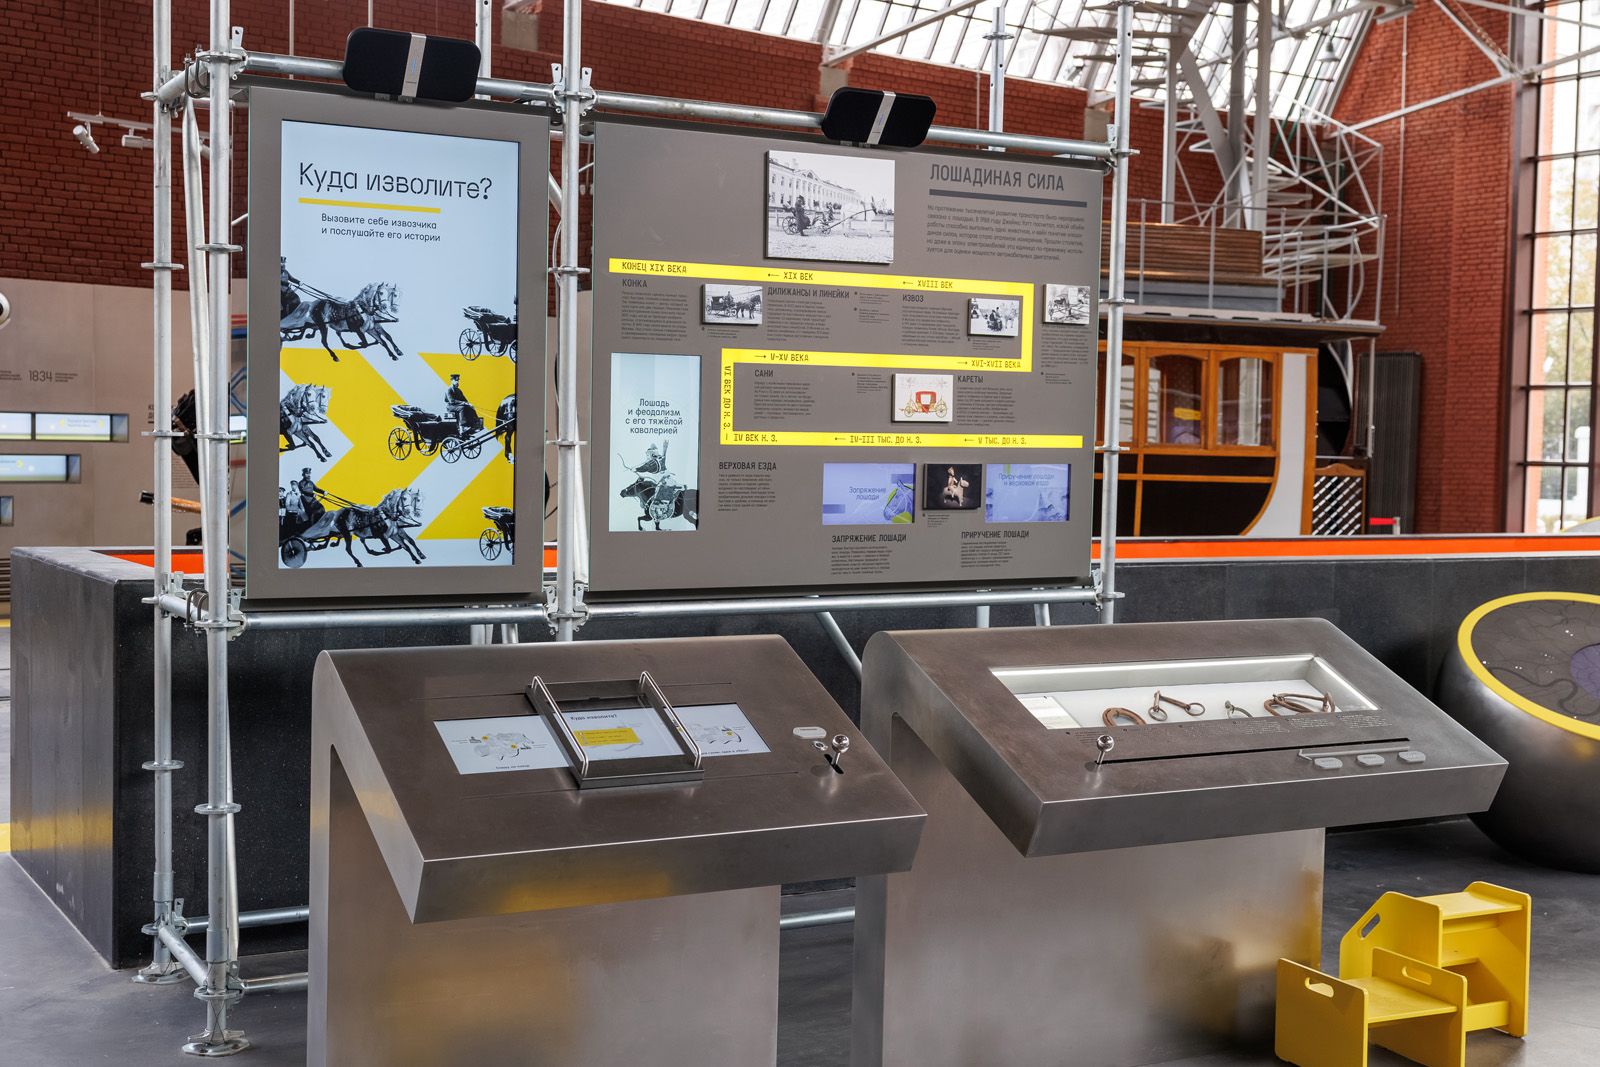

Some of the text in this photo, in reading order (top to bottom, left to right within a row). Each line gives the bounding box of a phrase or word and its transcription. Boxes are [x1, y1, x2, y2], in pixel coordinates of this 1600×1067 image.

[299, 162, 493, 200] Куда изволите?
[930, 163, 1065, 192] ЛОШАДИНАЯ СИЛА
[321, 213, 437, 230] Вызовите себе извозчика
[330, 228, 385, 240] послушайте
[387, 231, 402, 241] его
[404, 233, 441, 243] истории
[621, 261, 687, 274] КОНЕЦ XIX ВЕКА
[783, 271, 813, 281] XIX ВЕК
[622, 278, 648, 288] КОНКА
[917, 280, 953, 290] XVIII ВЕК
[767, 286, 850, 299] ДИЛИЖАНСЫ И ЛИНЕЙКИ
[902, 294, 924, 303] ИЗВОЗ
[790, 354, 809, 362] ВЕКА
[1004, 360, 1021, 369] ВЕКА
[28, 369, 53, 382] 1834
[724, 365, 732, 377] VI
[754, 369, 774, 378] САНИ
[957, 375, 984, 384] КАРЕТЫ
[724, 379, 732, 395] ВЕК
[639, 398, 670, 408] Лошадь
[635, 408, 680, 417] феодализм
[649, 417, 683, 425] тяжёлой
[630, 427, 678, 436] кавалерией
[733, 433, 743, 442] IV
[745, 433, 759, 442] ВЕК
[761, 434, 769, 442] Н.
[877, 435, 893, 444] ТЫС.
[895, 436, 905, 445] ДО
[985, 436, 1000, 445] ТЫС.
[718, 461, 777, 471] ВЕРХОВАЯ ЕЗДА
[831, 533, 907, 543] ЗАПРЯЖЕНИЕ ЛОШАДИ
[961, 530, 1030, 539] ПРИРУЧЕНИЕ ЛОШАДИ
